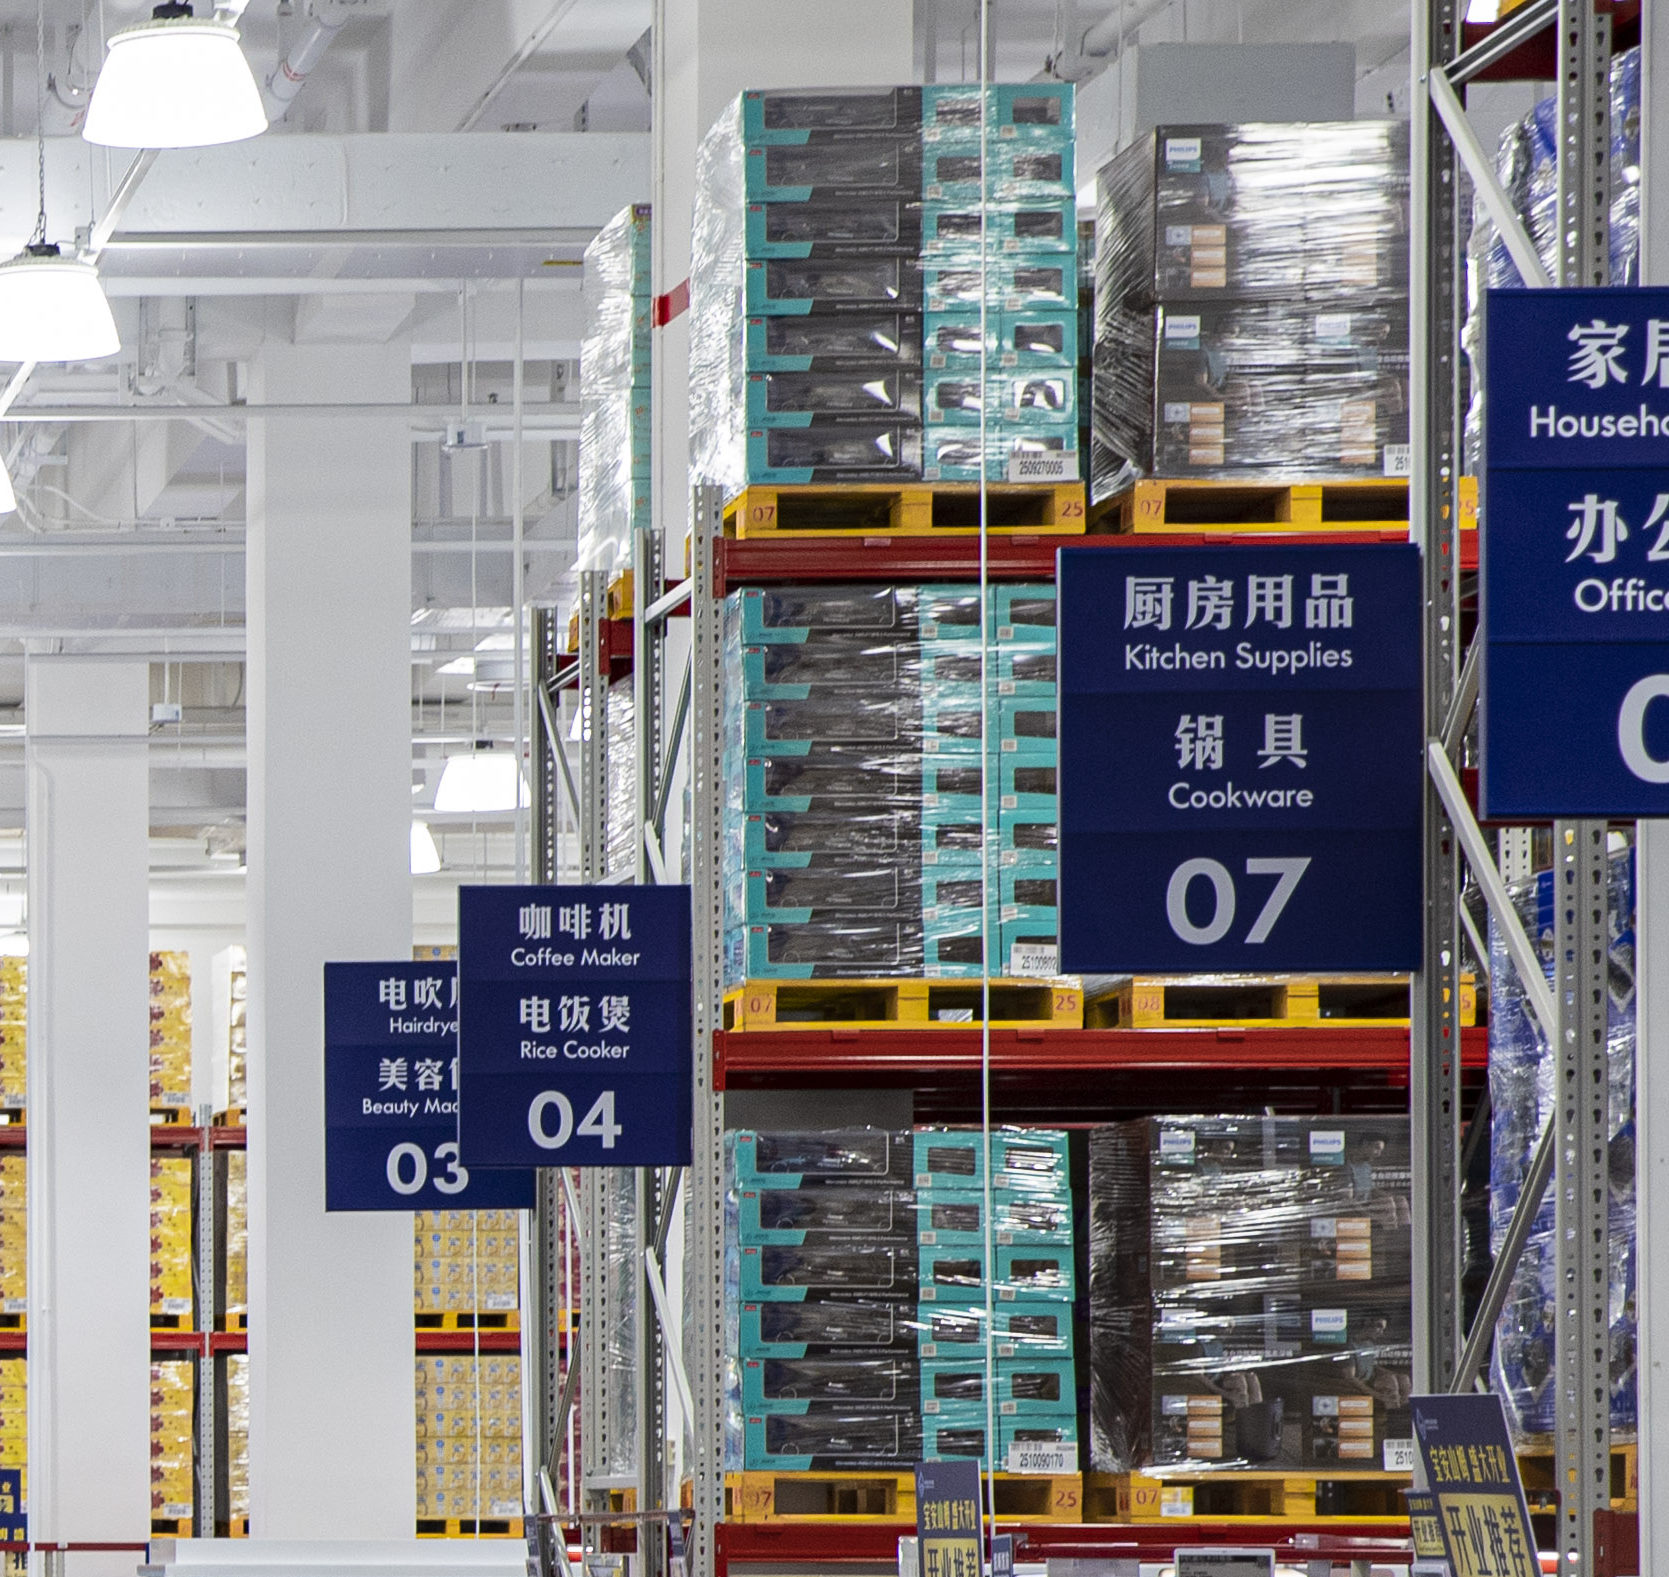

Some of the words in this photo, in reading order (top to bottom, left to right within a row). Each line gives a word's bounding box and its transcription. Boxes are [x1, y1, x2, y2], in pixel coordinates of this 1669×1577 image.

[752, 505, 776, 523] 07
[1061, 500, 1084, 519] 25
[1139, 498, 1164, 517] 07
[1123, 573, 1354, 630] 厨房用品
[1125, 641, 1225, 670] Kitchen
[1236, 641, 1353, 675] Supplies
[1174, 713, 1308, 770] 锅具
[1168, 780, 1314, 809] Cookware
[1165, 856, 1312, 945] 07
[519, 902, 632, 941] 咖啡机
[511, 947, 575, 967] Coffee
[580, 947, 640, 967] Maker
[749, 996, 774, 1015] 07
[1055, 994, 1078, 1012] 25
[519, 995, 631, 1034] 电饭煲
[520, 1040, 558, 1059] Rice
[563, 1040, 630, 1059] Cooker
[363, 1098, 419, 1117] Beauty
[527, 1089, 622, 1149] 04
[386, 1142, 469, 1195] 03
[1019, 1453, 1064, 1468] 2510090170
[1055, 1490, 1078, 1509] 25
[1135, 1488, 1159, 1506] 07
